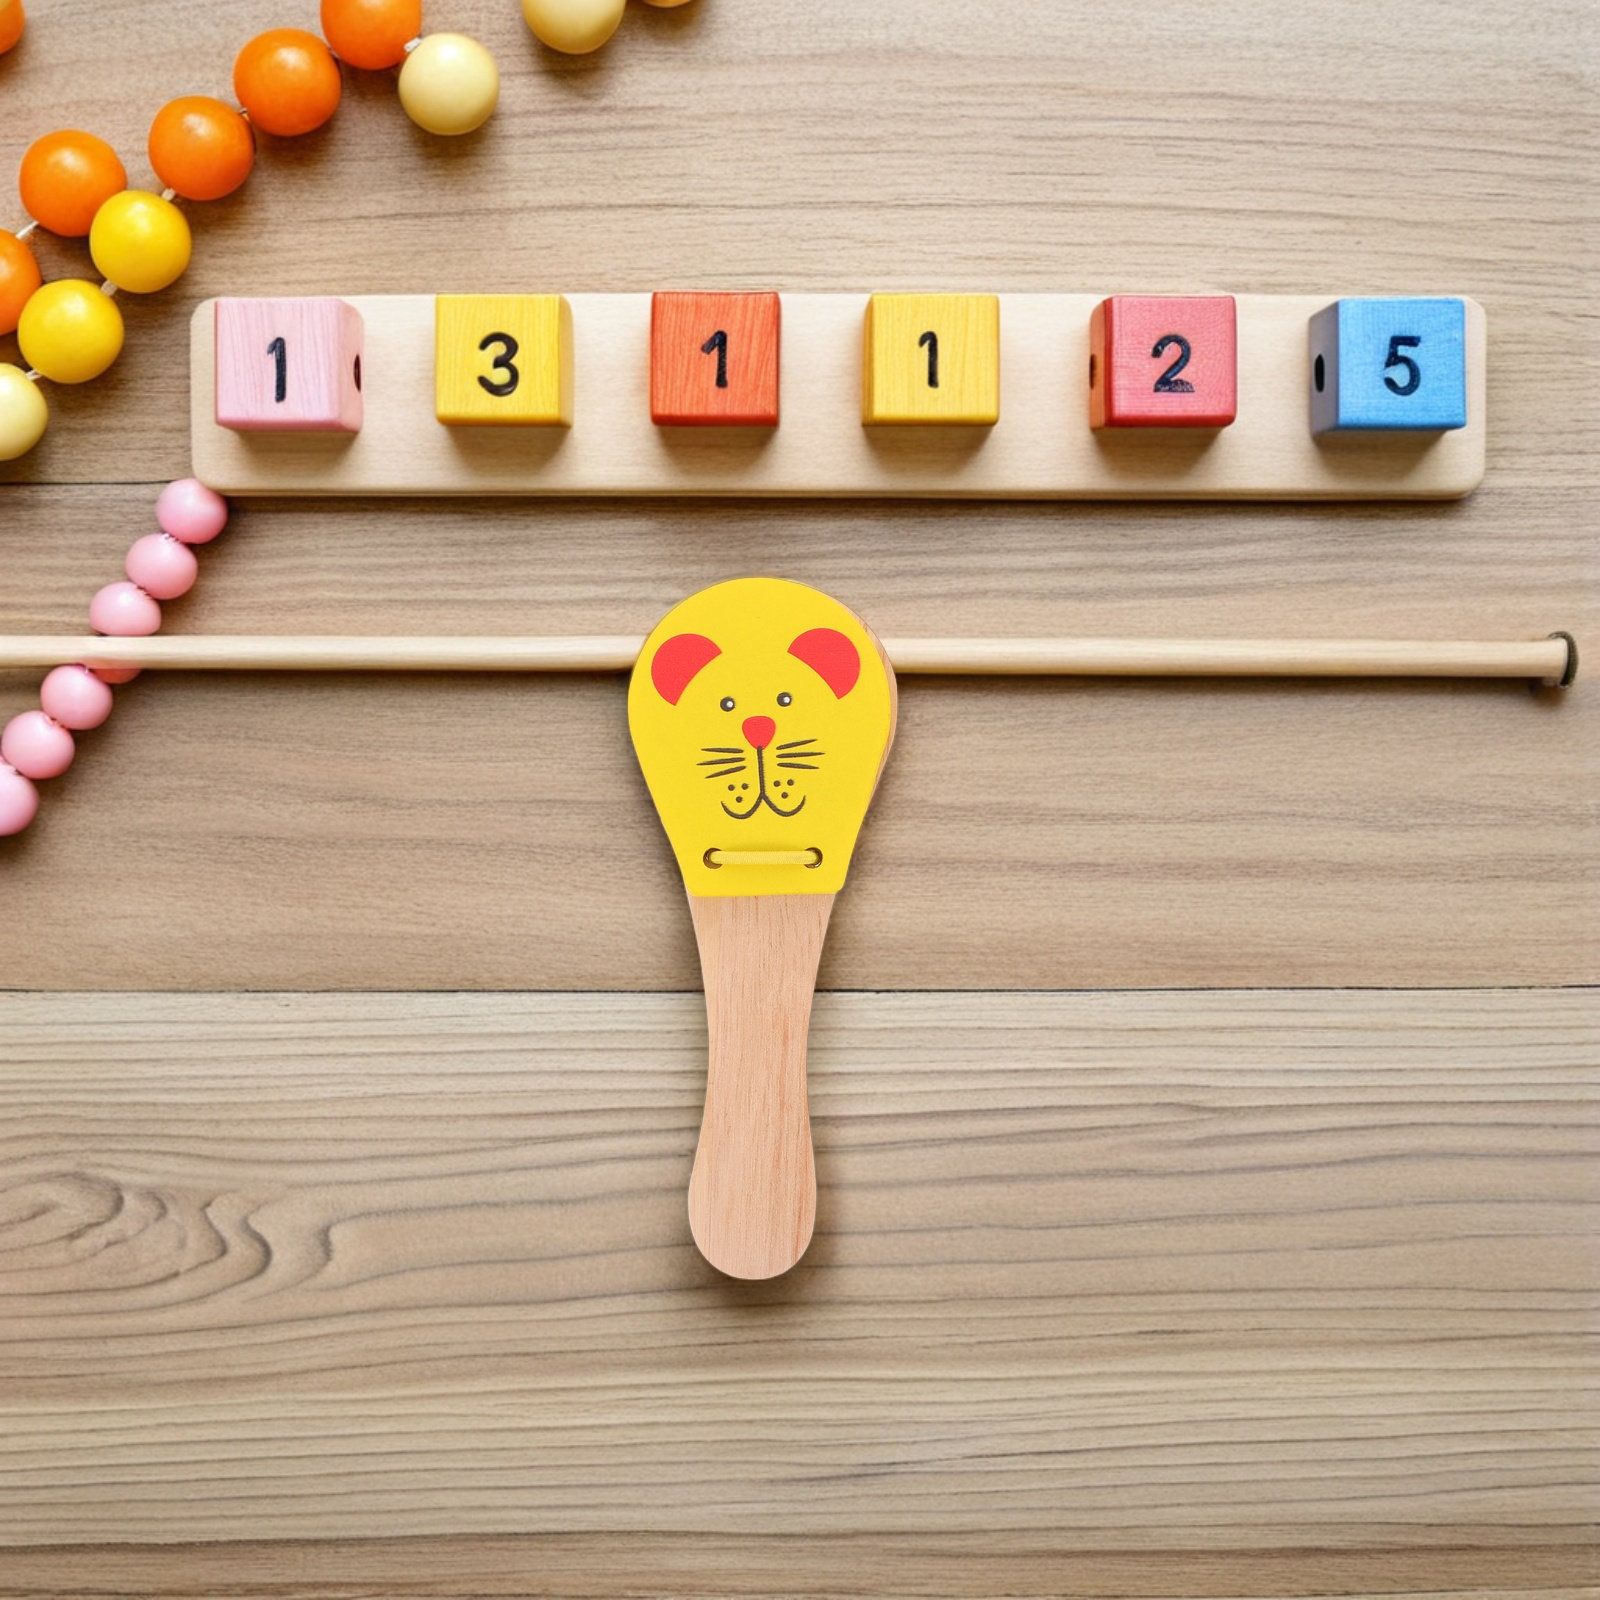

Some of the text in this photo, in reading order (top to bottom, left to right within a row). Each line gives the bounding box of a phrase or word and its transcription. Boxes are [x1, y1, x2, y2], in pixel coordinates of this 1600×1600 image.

[267, 330, 1421, 403] 1 3 1 1 2 5
